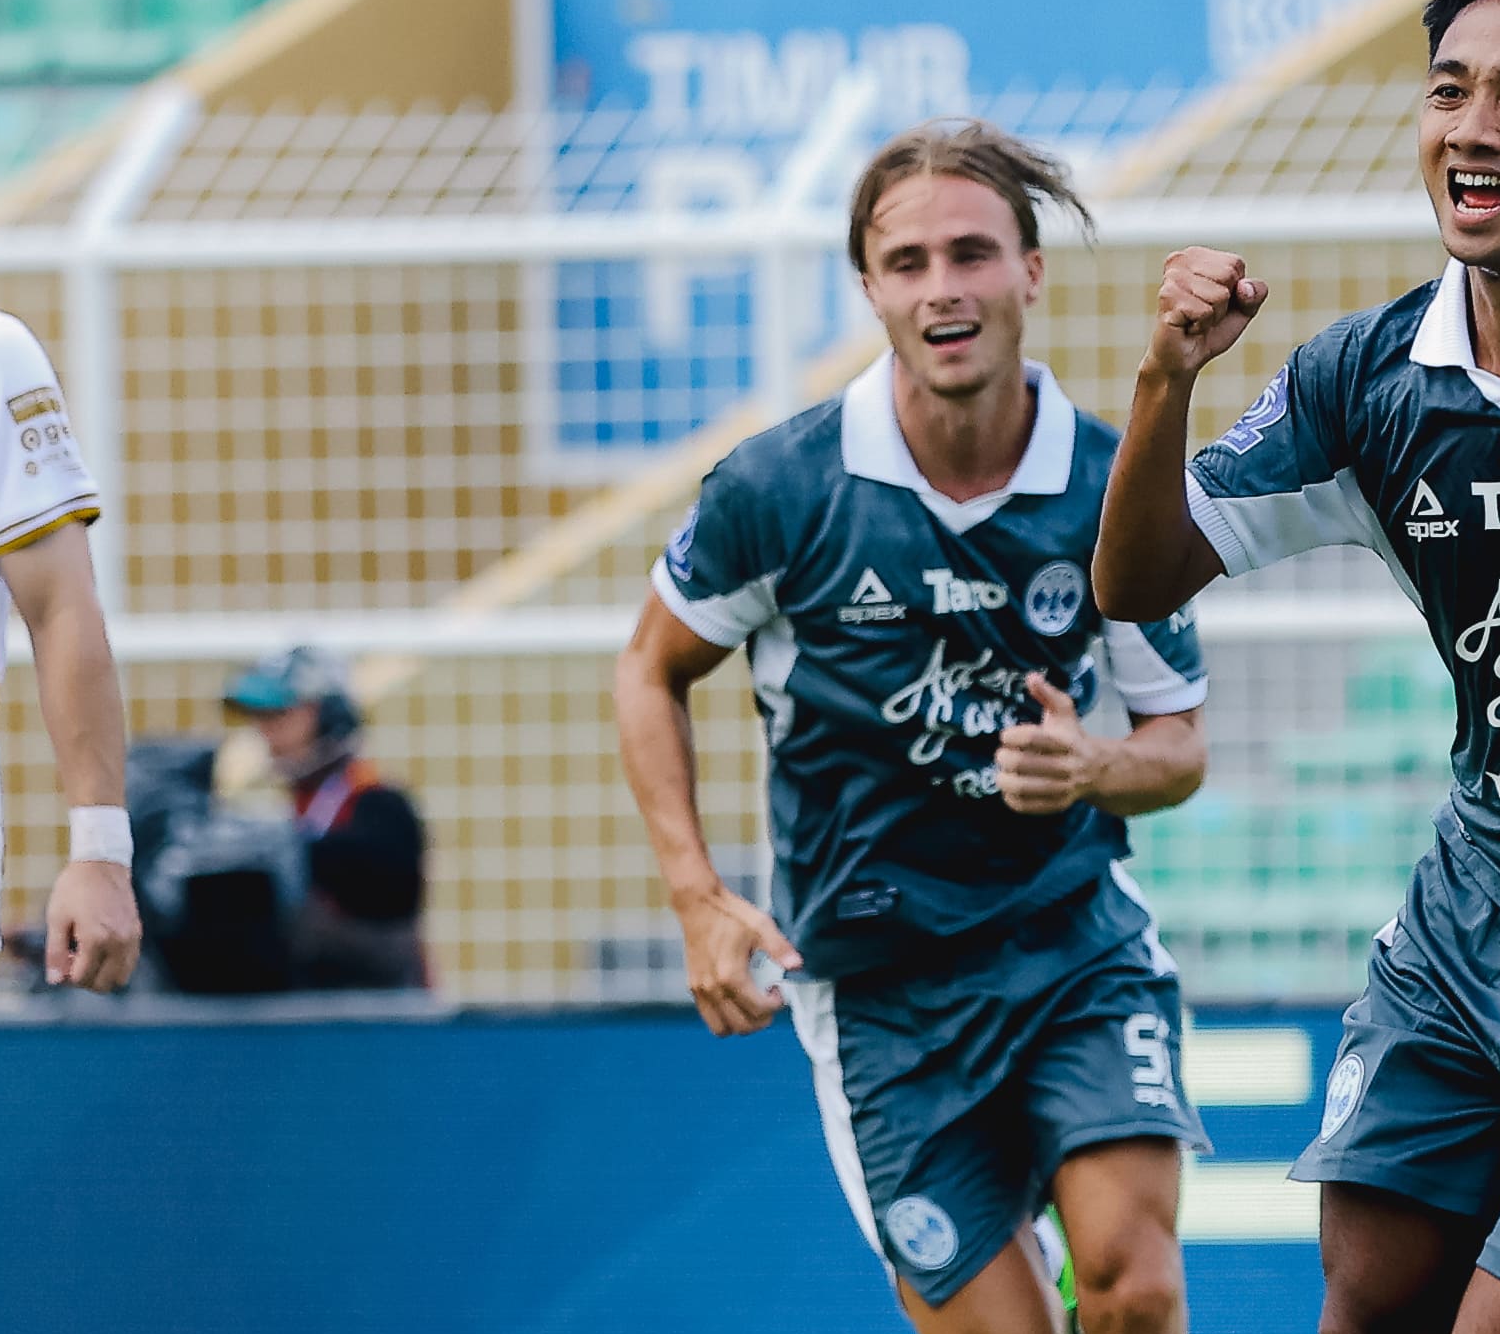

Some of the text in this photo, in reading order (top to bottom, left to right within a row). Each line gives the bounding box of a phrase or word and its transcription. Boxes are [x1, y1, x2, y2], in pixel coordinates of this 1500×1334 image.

[1405, 519, 1460, 542] apex
[922, 568, 1008, 614] Taro
[1123, 1013, 1175, 1088] 5
